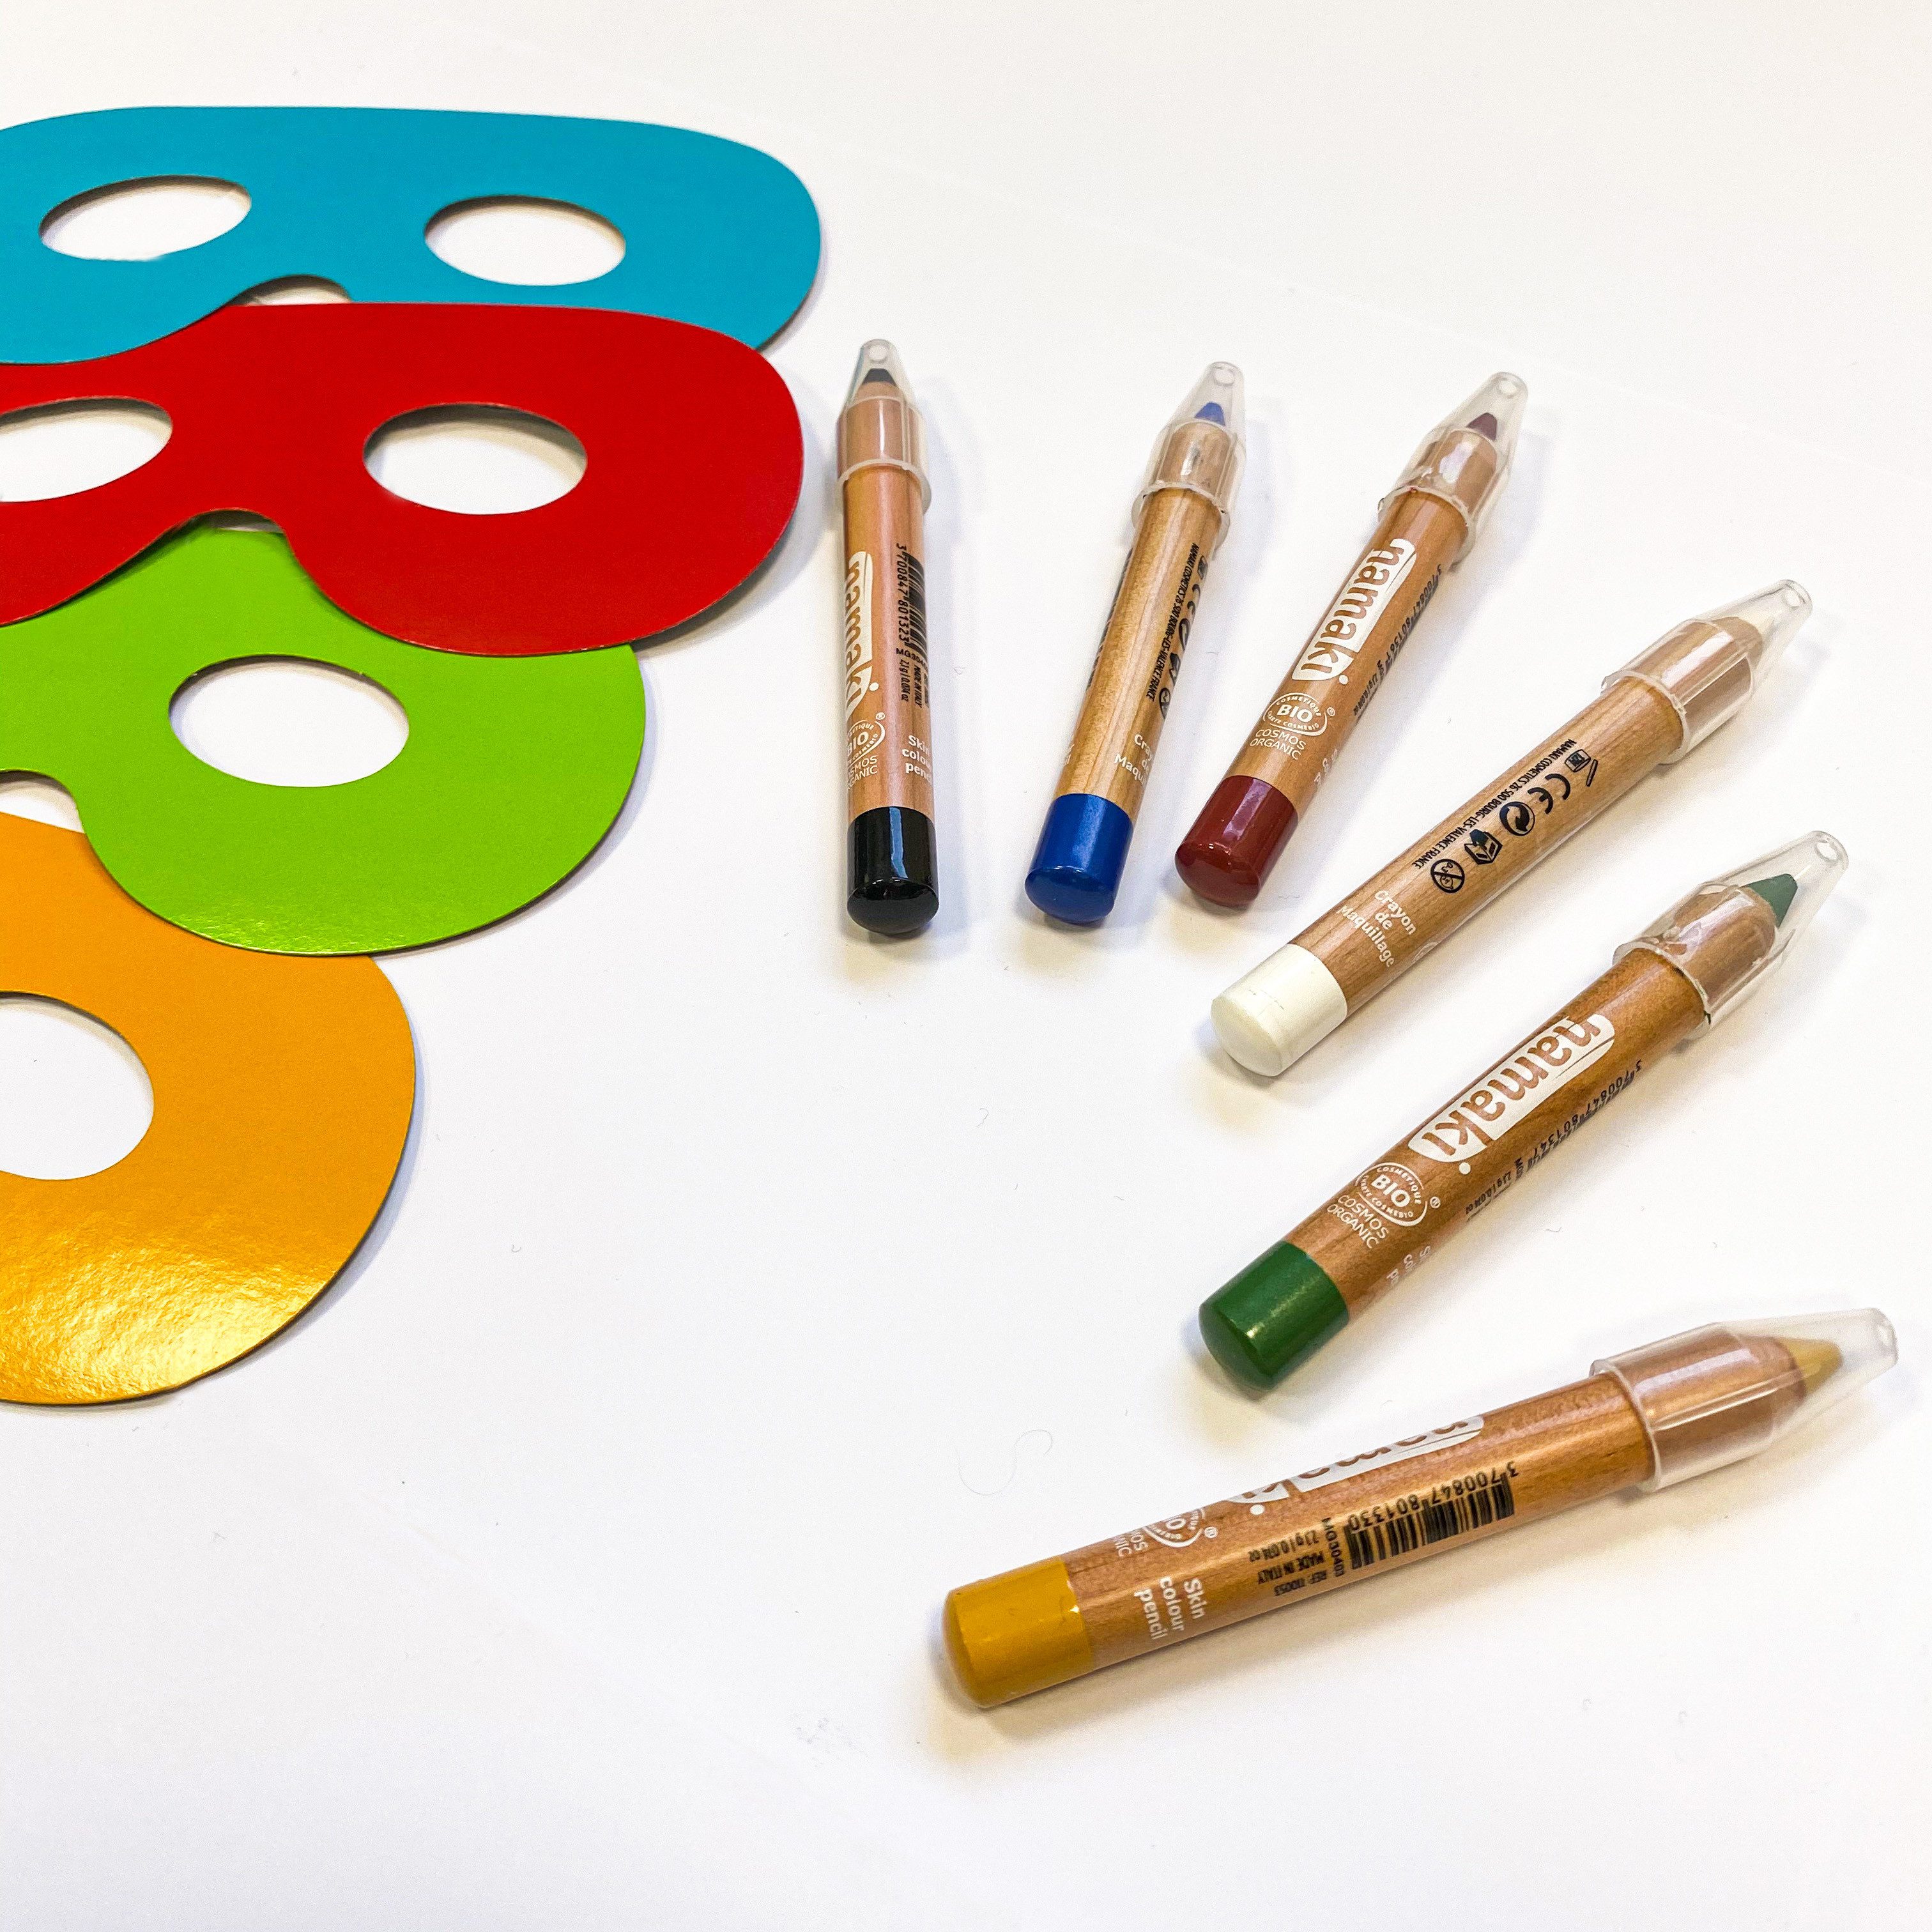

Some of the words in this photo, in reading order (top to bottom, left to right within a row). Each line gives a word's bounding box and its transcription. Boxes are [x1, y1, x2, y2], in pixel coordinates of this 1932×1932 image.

[897, 554, 906, 594] 700847
[845, 561, 880, 709] namaki
[898, 600, 908, 642] 801323
[1300, 549, 1405, 686] namaki
[1276, 702, 1311, 722] BIO
[1248, 736, 1301, 760] ORGANIC
[1255, 728, 1307, 751] COSMOS
[1548, 737, 1576, 761] NAMAKI
[1510, 780, 1521, 792] 26
[1517, 756, 1552, 786] COSMETICS
[1496, 786, 1513, 802] 500
[1411, 845, 1440, 870] FRANCE
[1373, 888, 1417, 935] Crayon
[1373, 910, 1393, 931] de
[1335, 904, 1397, 967] Maquillage
[1420, 1026, 1602, 1176] namaki
[1370, 1174, 1409, 1209] BIO
[1326, 1202, 1380, 1249] ORGANIC
[1337, 1193, 1390, 1239] COSMOS
[1429, 1467, 1501, 1505] 700847
[1506, 1460, 1519, 1478] 3
[1347, 1494, 1420, 1531] 801330
[1133, 1587, 1169, 1640] pencil
[1157, 1575, 1184, 1632] colour
[1182, 1576, 1207, 1619] Skin
